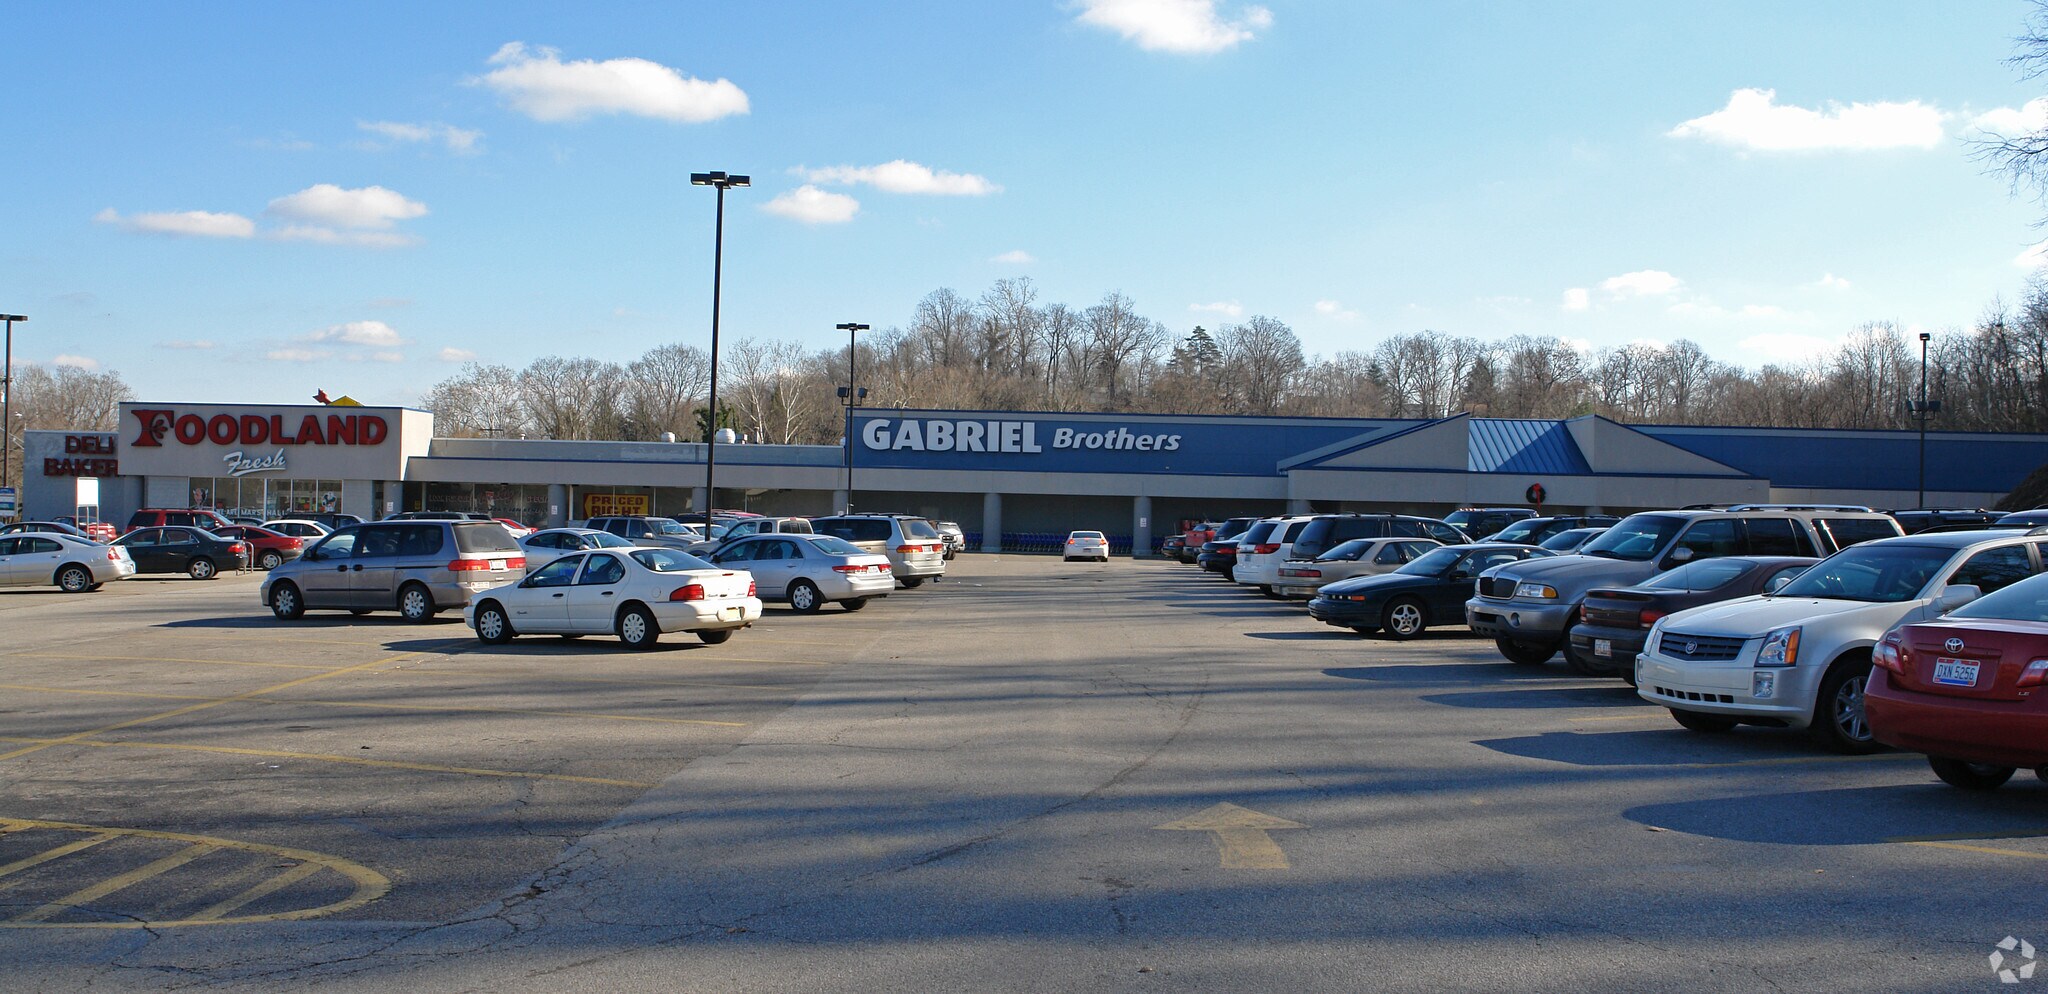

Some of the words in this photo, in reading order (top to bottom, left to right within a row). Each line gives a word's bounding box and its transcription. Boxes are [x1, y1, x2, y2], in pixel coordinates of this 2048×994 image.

[131, 409, 388, 447] FOODLAND
[862, 419, 1042, 453] GABRIEL
[1052, 427, 1182, 451] Brothers
[65, 435, 113, 454] DELI
[223, 448, 287, 477] Fresh
[591, 495, 644, 505] PRICED
[591, 506, 641, 517] RIGHT
[1937, 665, 1953, 677] DXN
[1954, 666, 1975, 680] 5256
